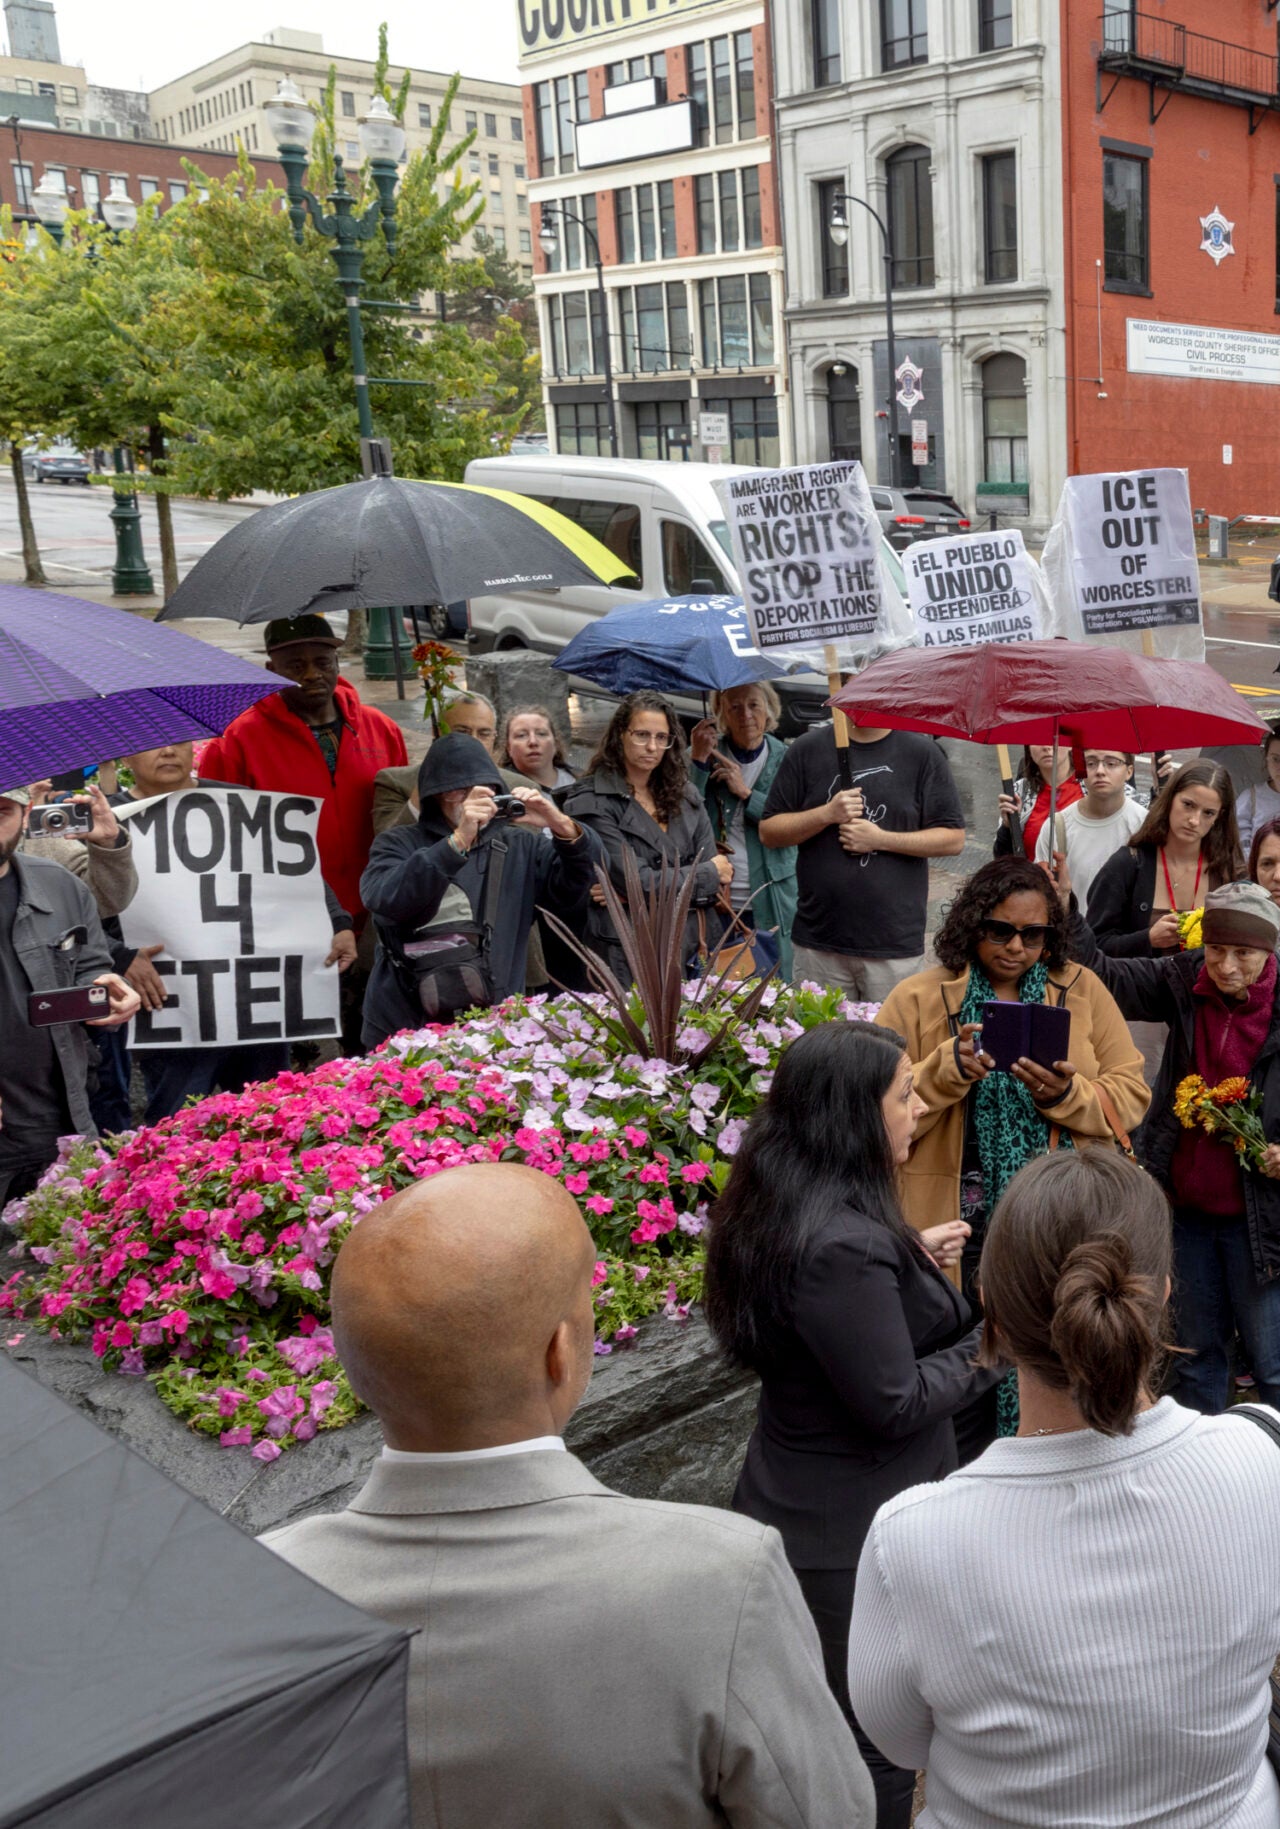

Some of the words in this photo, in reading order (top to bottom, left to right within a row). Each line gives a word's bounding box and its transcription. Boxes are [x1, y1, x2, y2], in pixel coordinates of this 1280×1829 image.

[1132, 323, 1148, 332] NEED
[1148, 324, 1182, 336] DOCUMENTS
[1206, 330, 1216, 339] LET
[1216, 331, 1226, 340] THE
[1227, 332, 1267, 344] PROFESSIONALS
[1148, 334, 1193, 348] WORCESTER
[1194, 339, 1222, 350] COUNTY
[1258, 346, 1280, 356] OFFICE
[1186, 350, 1206, 361] CIVIL
[1209, 352, 1246, 364] PROCESS
[730, 472, 805, 498] IMMIGRANT
[1102, 476, 1158, 512] ICE
[736, 503, 757, 518] ARE
[738, 510, 871, 563] RIGHTS!
[1102, 516, 1161, 549] OUT
[912, 552, 942, 578] ¡EL
[945, 540, 1016, 568] PUEBLO
[1120, 554, 1148, 576] OF
[748, 561, 822, 605] STOP
[829, 558, 876, 594] THE
[924, 562, 1013, 602] UNIDO
[1081, 576, 1192, 604] WORCESTER!
[925, 587, 1023, 622] DEFENDERÁ
[1086, 613, 1105, 622] Party
[1116, 606, 1152, 618] Socialism
[1152, 604, 1167, 614] and
[762, 631, 784, 644] PARTY
[784, 630, 800, 641] FOR
[800, 625, 837, 639] SOCIALISM
[838, 624, 843, 634] &
[924, 632, 934, 646] A
[938, 627, 965, 644] LAS
[968, 616, 1032, 639] FAMILIAS
[1087, 619, 1123, 629] Liberation
[129, 792, 317, 876] MOMS
[200, 873, 254, 956] 4
[134, 955, 338, 1044] ETEL
